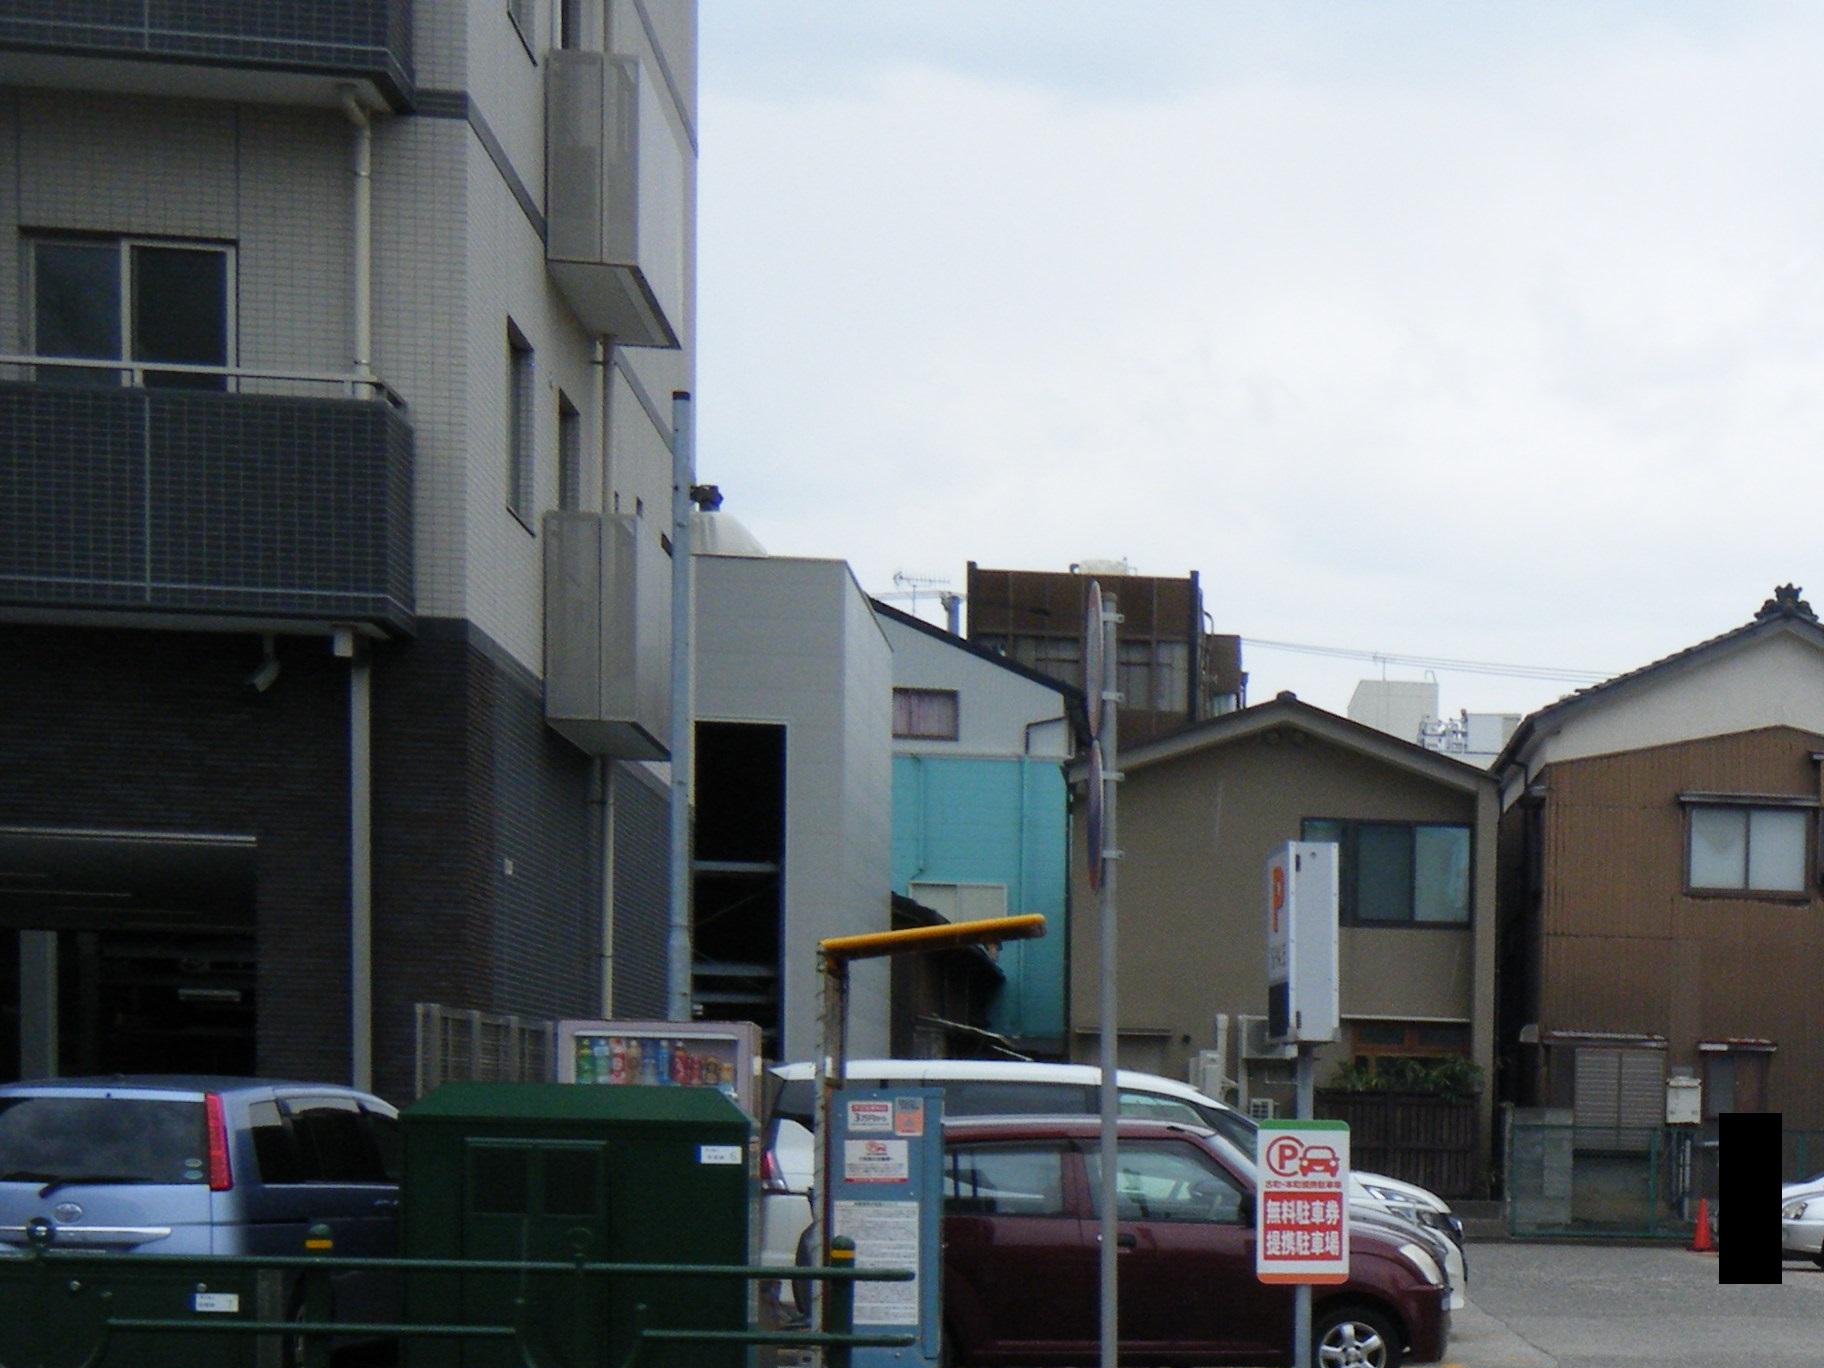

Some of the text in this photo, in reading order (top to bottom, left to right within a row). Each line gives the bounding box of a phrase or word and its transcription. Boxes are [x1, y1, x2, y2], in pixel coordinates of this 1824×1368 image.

[1272, 866, 1285, 933] P
[1278, 1144, 1299, 1170] P
[1266, 1199, 1340, 1225] 無料駐車券
[1266, 1230, 1340, 1256] 提携駐車場
